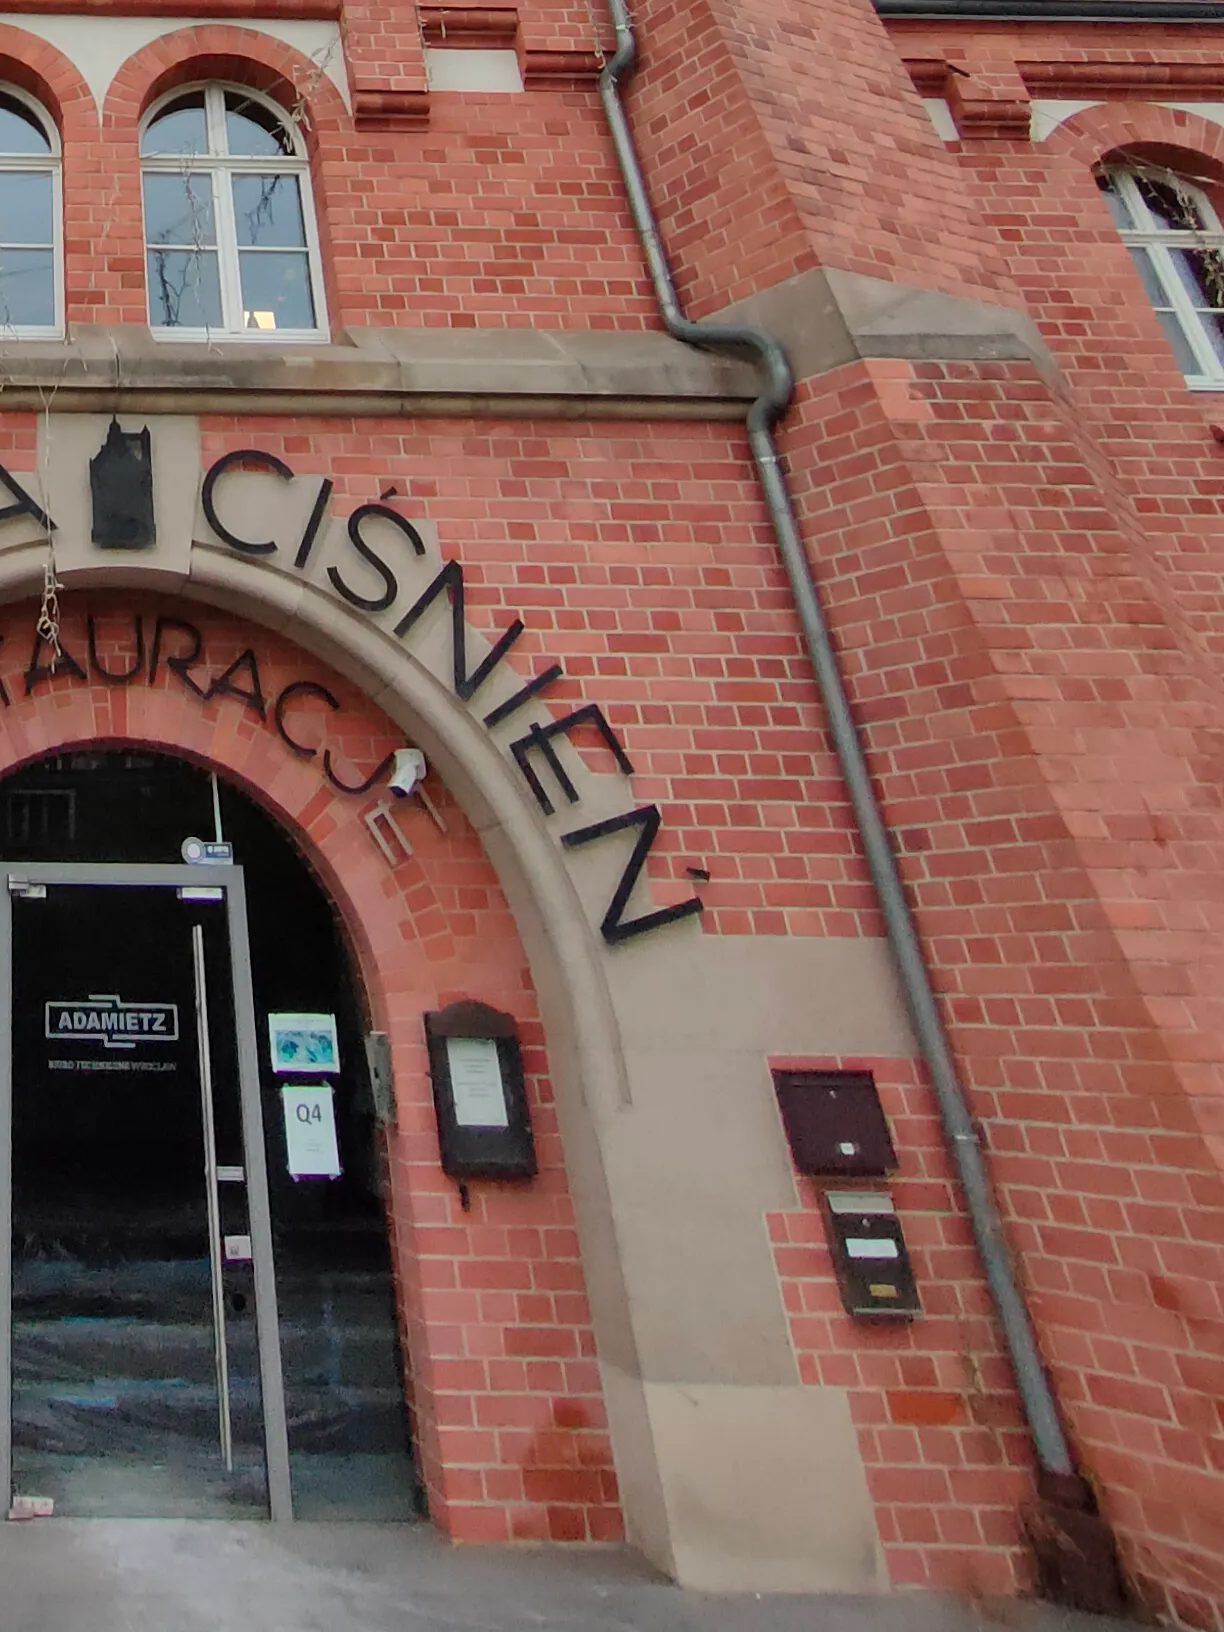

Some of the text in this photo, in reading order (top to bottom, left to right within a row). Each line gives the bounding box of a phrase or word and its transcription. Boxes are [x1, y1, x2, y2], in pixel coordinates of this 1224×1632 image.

[201, 448, 711, 946] CIŚNIEŃ
[58, 1011, 167, 1031] ADAMIETZ
[295, 1103, 322, 1126] Q4
